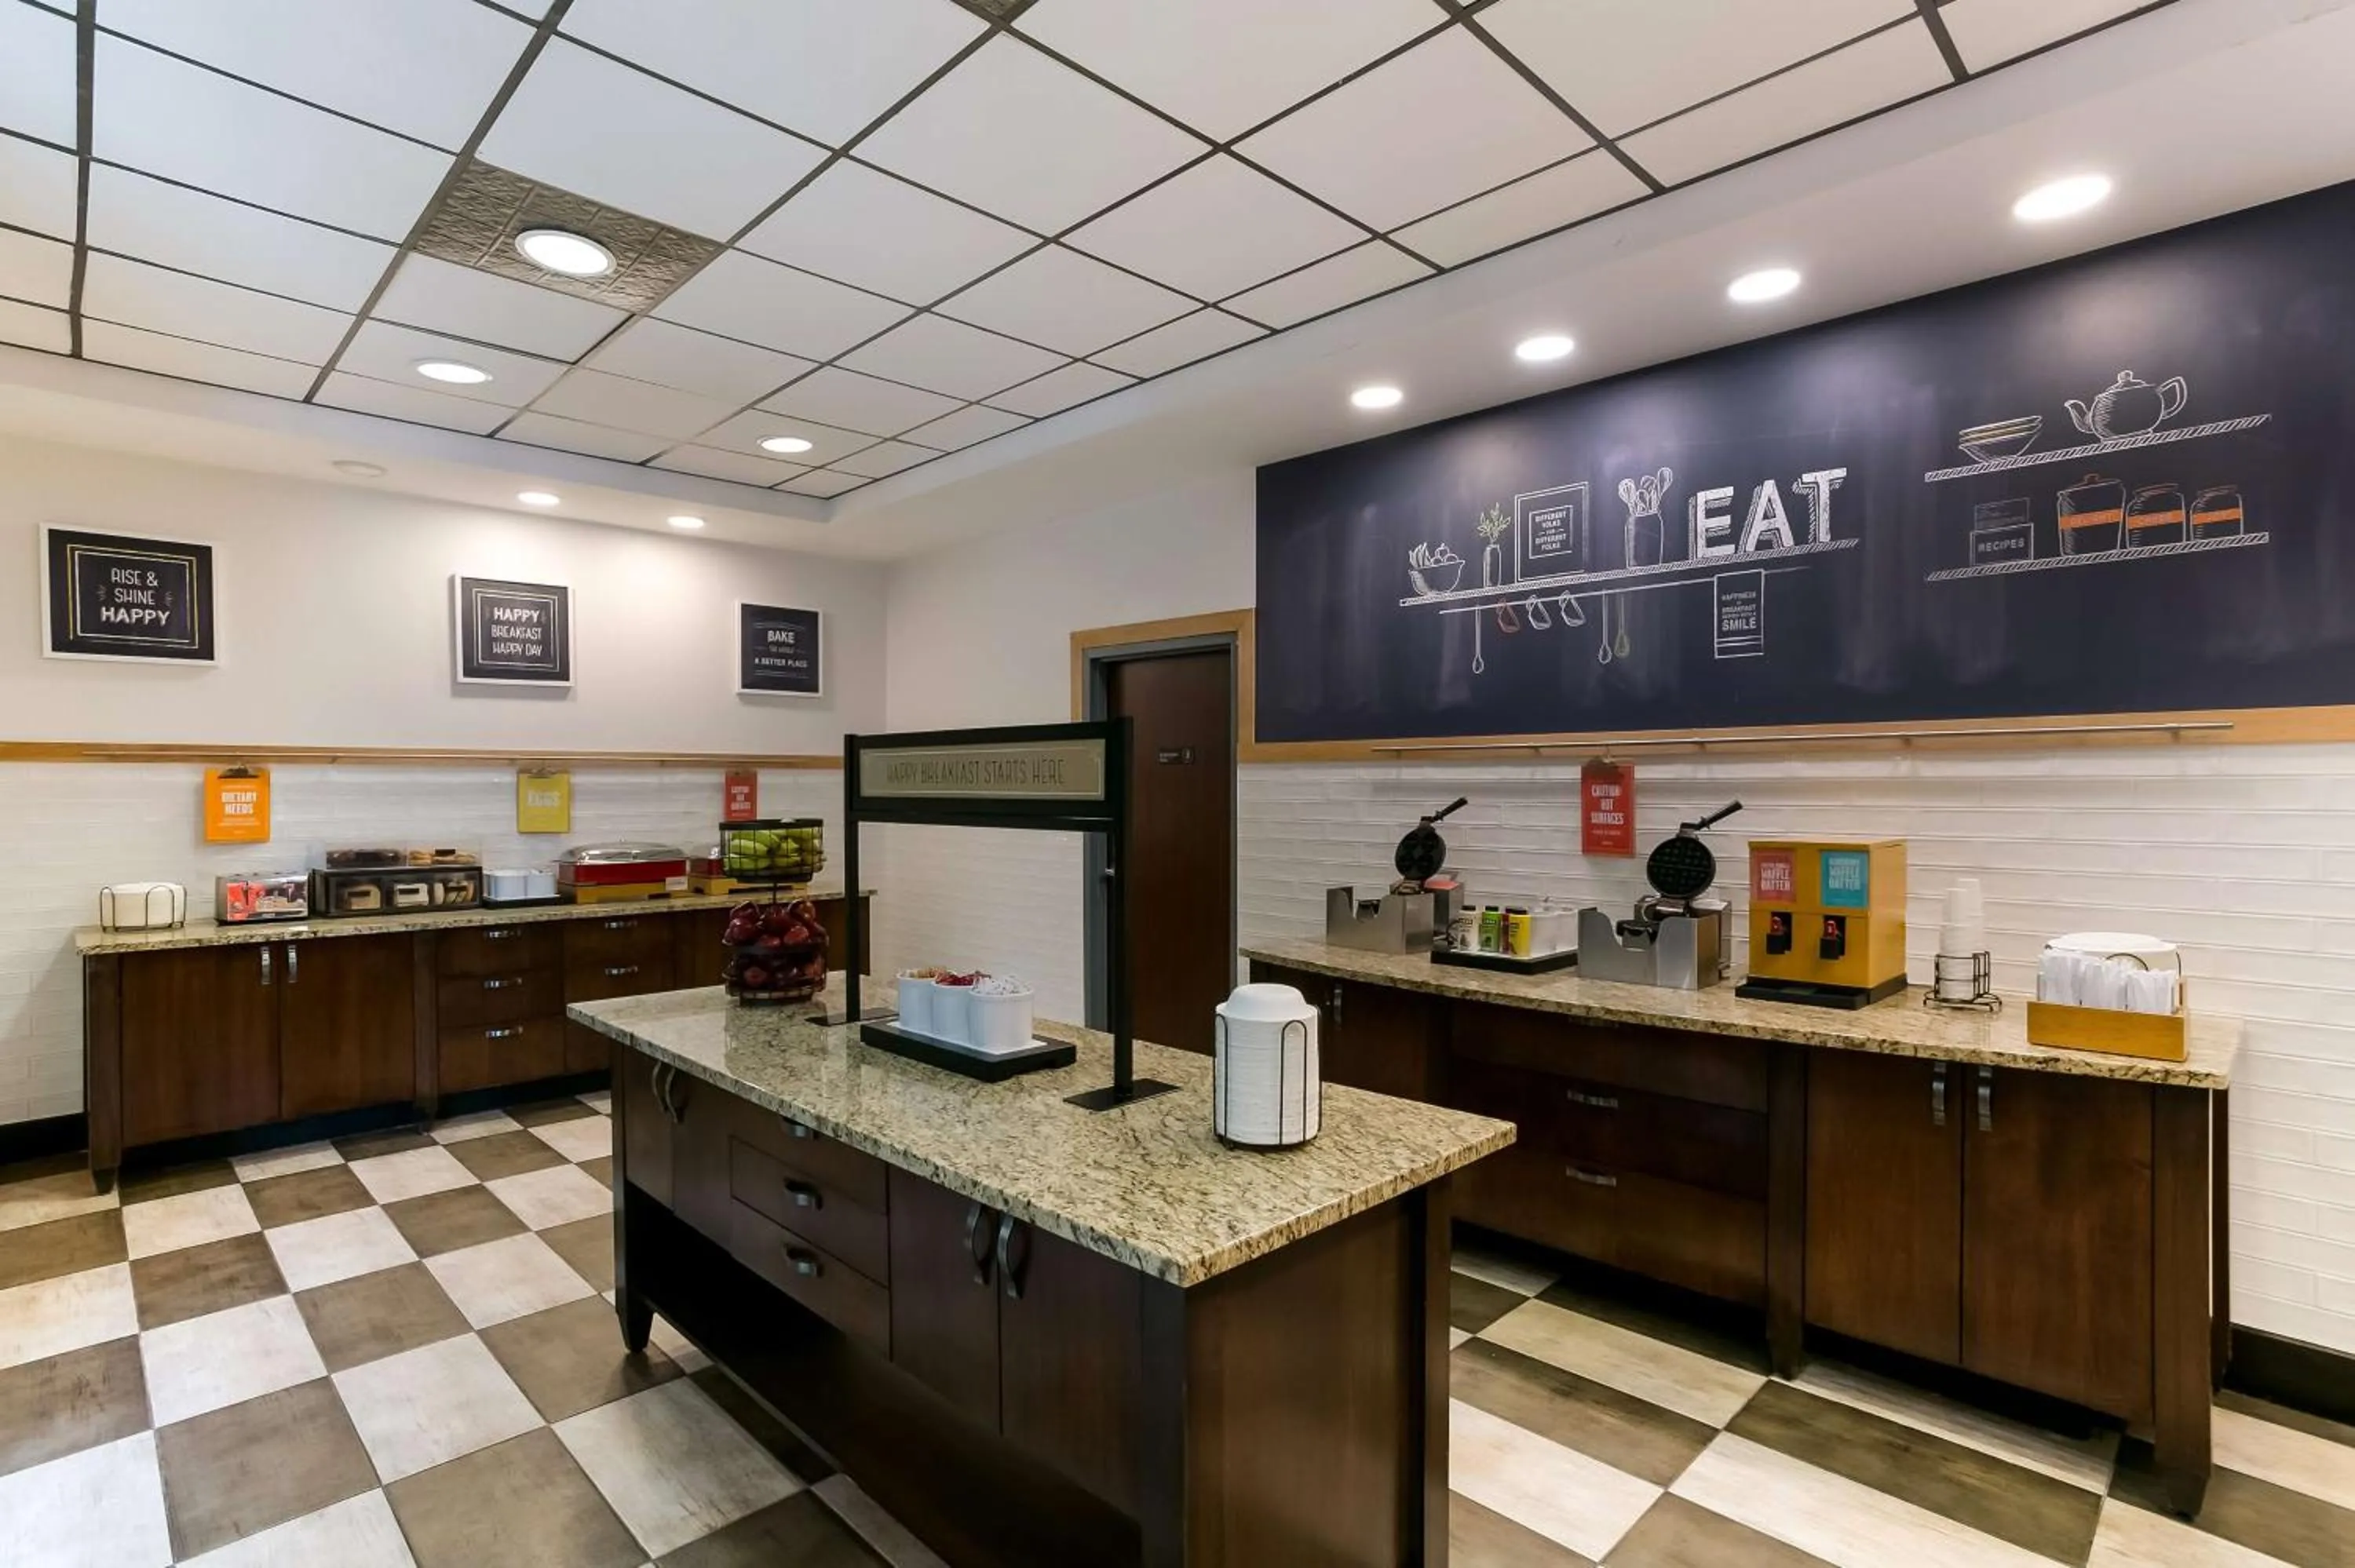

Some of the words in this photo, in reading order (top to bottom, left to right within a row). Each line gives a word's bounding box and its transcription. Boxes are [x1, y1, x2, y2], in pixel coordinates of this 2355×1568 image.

[1689, 467, 1847, 560] EAT
[1978, 538, 2025, 552] RECIPES
[111, 567, 142, 585] RISE
[146, 571, 159, 587] &
[114, 588, 156, 605] SHINE
[100, 607, 170, 625] HAPPY
[493, 607, 540, 623] HAPPY
[491, 624, 542, 640] BREAKFAST
[1722, 617, 1757, 632] SMILE
[767, 630, 795, 644] BAKE
[492, 641, 524, 655] HAPPY
[525, 644, 542, 657] DAY
[921, 760, 979, 784] BREAKFAST
[984, 760, 1027, 784] STARTS
[1032, 758, 1066, 784] HERE
[225, 802, 254, 815] NEEDS
[1761, 867, 1791, 880] WAFFLE
[1761, 879, 1791, 892] BATTER
